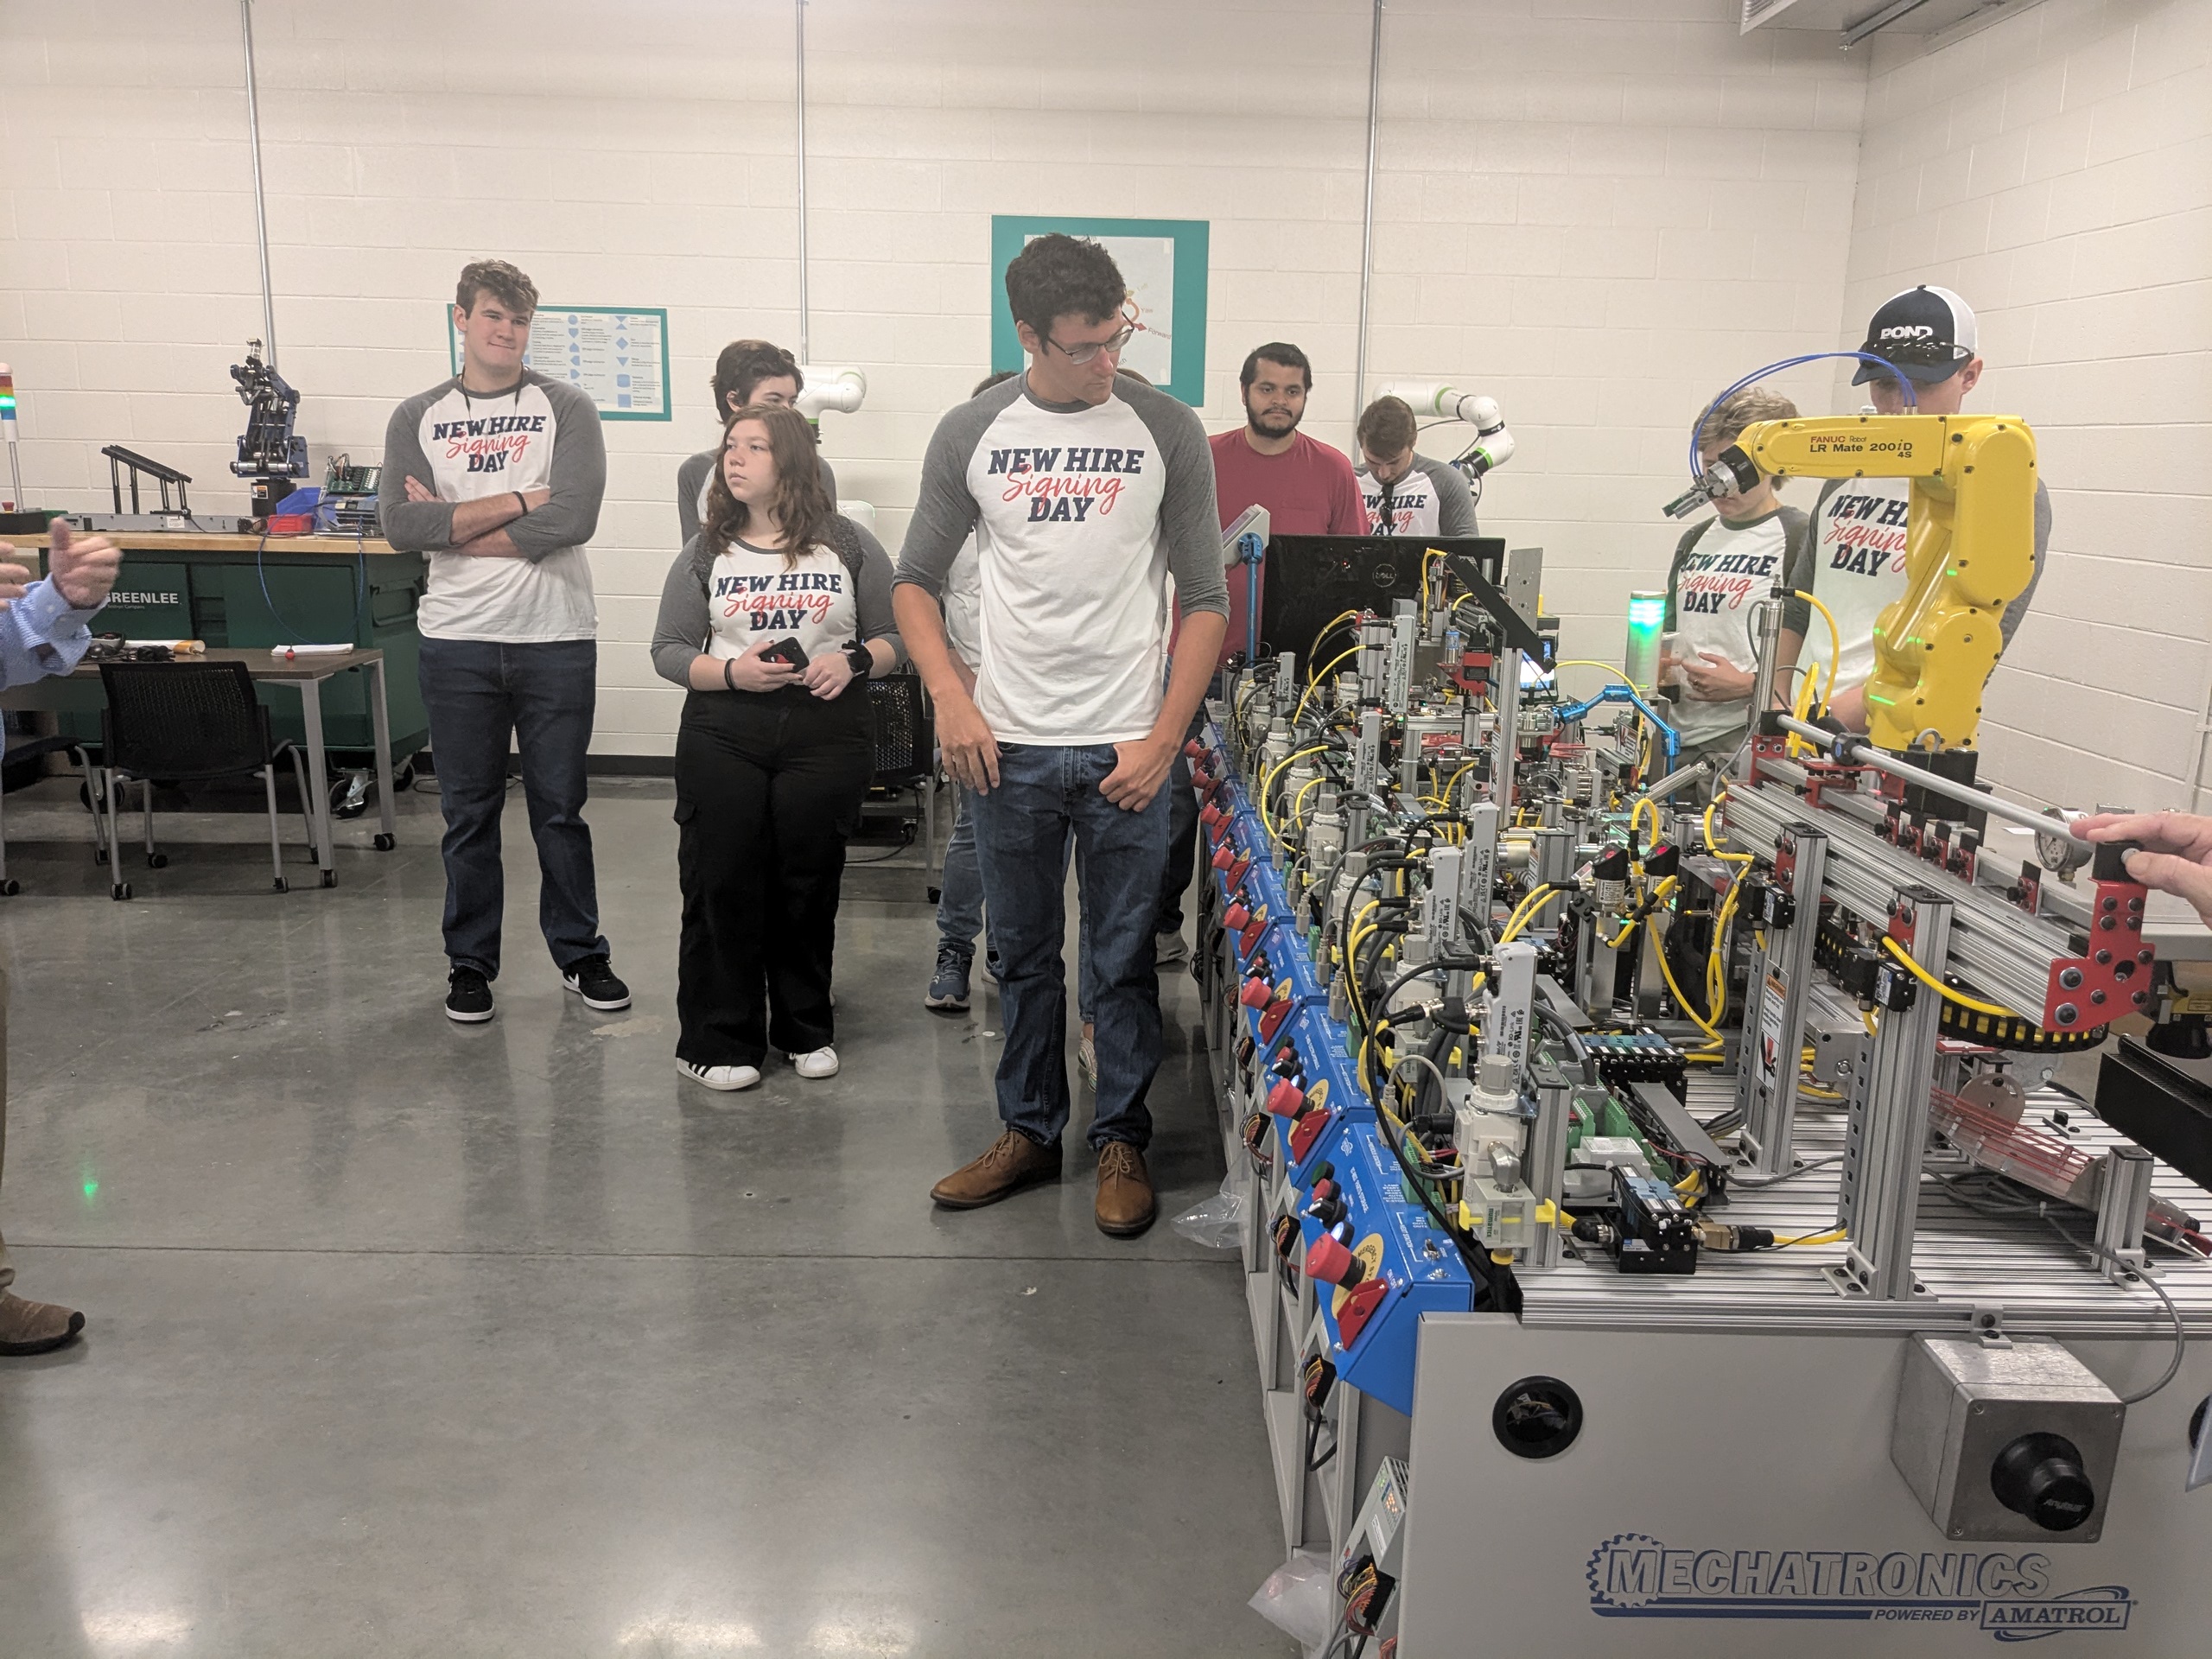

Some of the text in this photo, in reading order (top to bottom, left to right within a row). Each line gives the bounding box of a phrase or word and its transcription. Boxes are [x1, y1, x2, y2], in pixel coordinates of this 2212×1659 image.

[1147, 327, 1173, 340] Forward
[1880, 326, 1934, 340] POND
[433, 416, 547, 441] NEW HIRE
[446, 431, 531, 463] Signing
[1809, 439, 1913, 453] LR Mate 200iD
[467, 450, 509, 474] DAY
[988, 447, 1145, 474] NEW HIRE
[1002, 463, 1126, 515] Signing
[1027, 497, 1095, 522] DAY
[1827, 494, 1885, 520] NEW
[1370, 523, 1398, 536] AY
[1713, 554, 1778, 576] HIRE
[1830, 543, 1891, 576] DAY
[715, 573, 842, 598] NEW HIRE
[723, 586, 834, 624] Signing
[1683, 591, 1726, 614] DAY
[750, 609, 808, 631] DAY
[1607, 1548, 2052, 1598] MECHATRONICS
[1874, 1607, 2120, 1624] POWERED BY AMATROL
